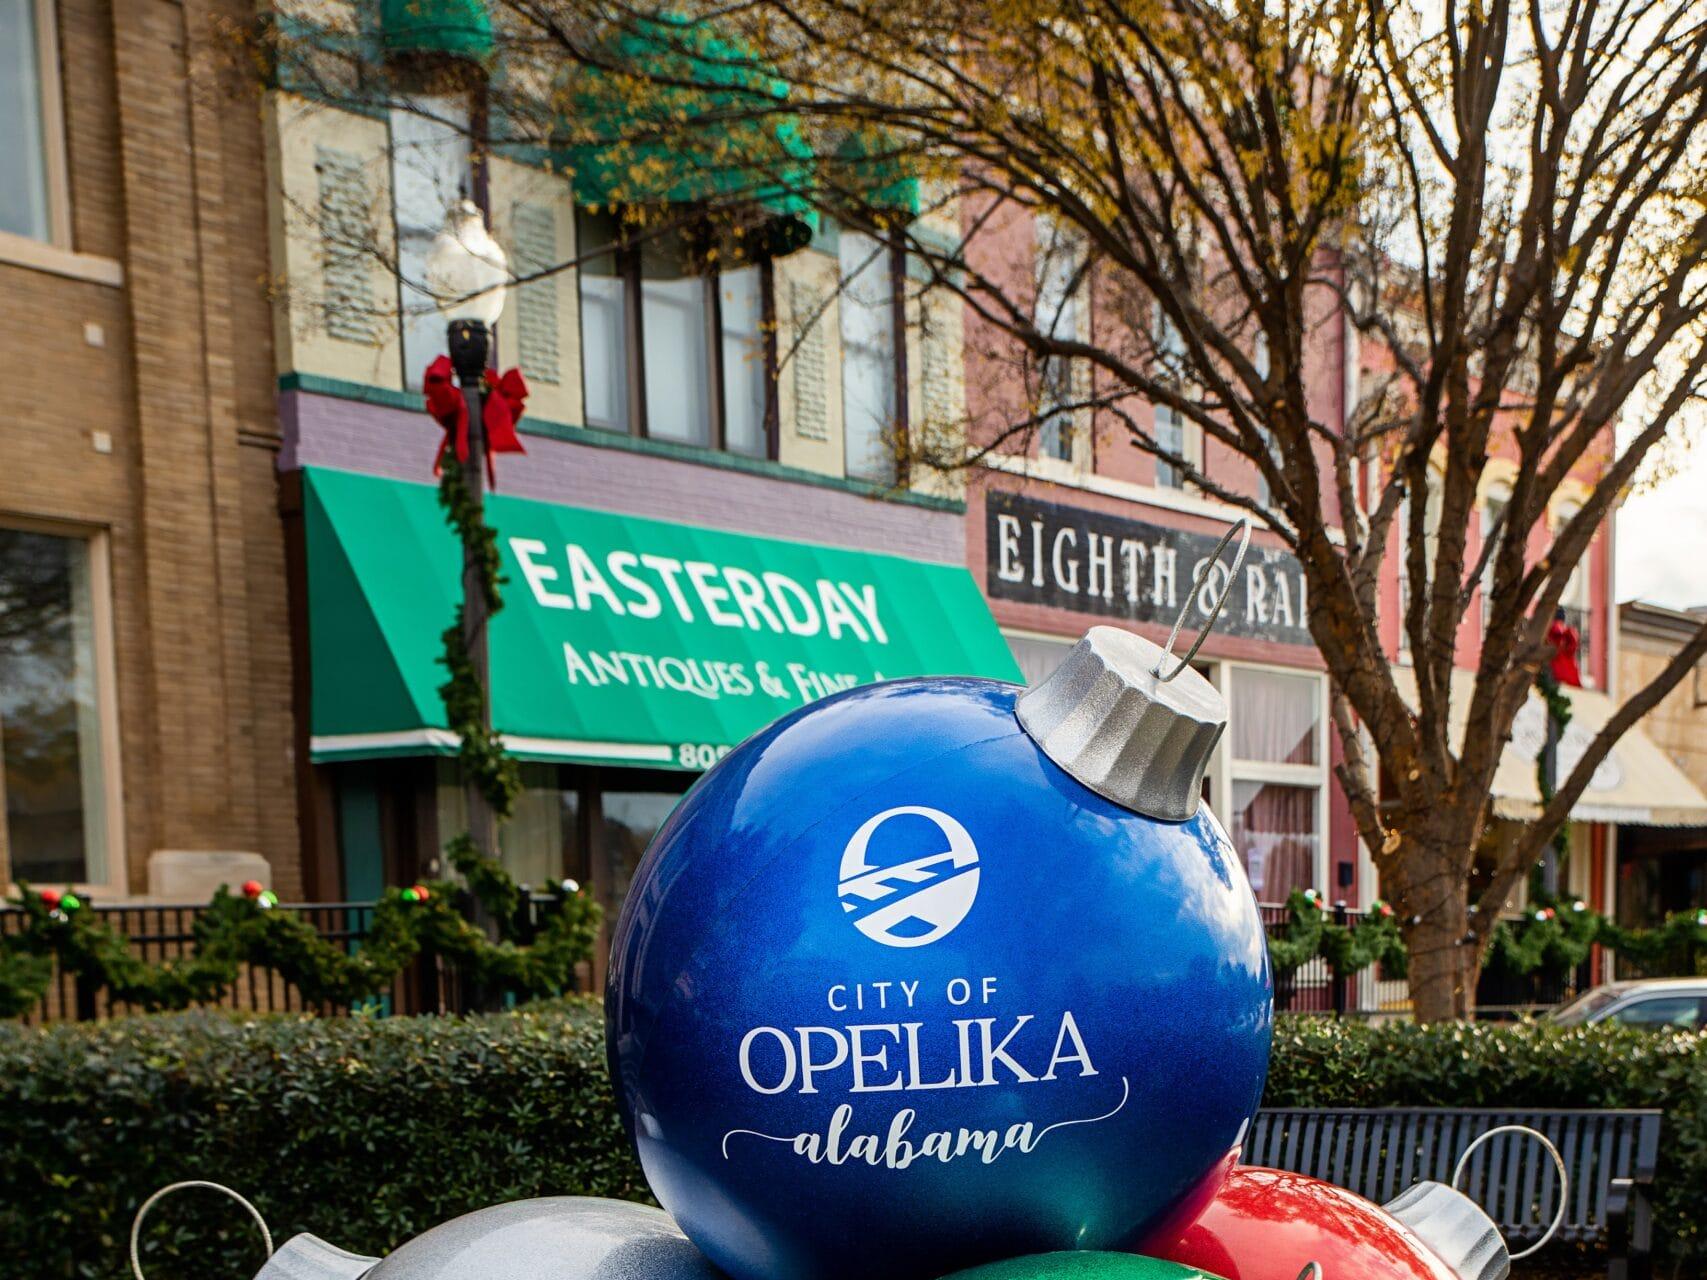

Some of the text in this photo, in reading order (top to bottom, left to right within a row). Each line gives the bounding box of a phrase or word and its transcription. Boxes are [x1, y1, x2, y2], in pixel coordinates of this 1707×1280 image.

[508, 537, 888, 645] EASTERDAY
[997, 514, 1177, 608] EIGHTH
[1192, 556, 1230, 619] &
[562, 641, 753, 700] ANTIQUES
[755, 660, 791, 699] &
[827, 976, 998, 1012] CITY OF
[737, 1010, 1100, 1095] OPELIKA
